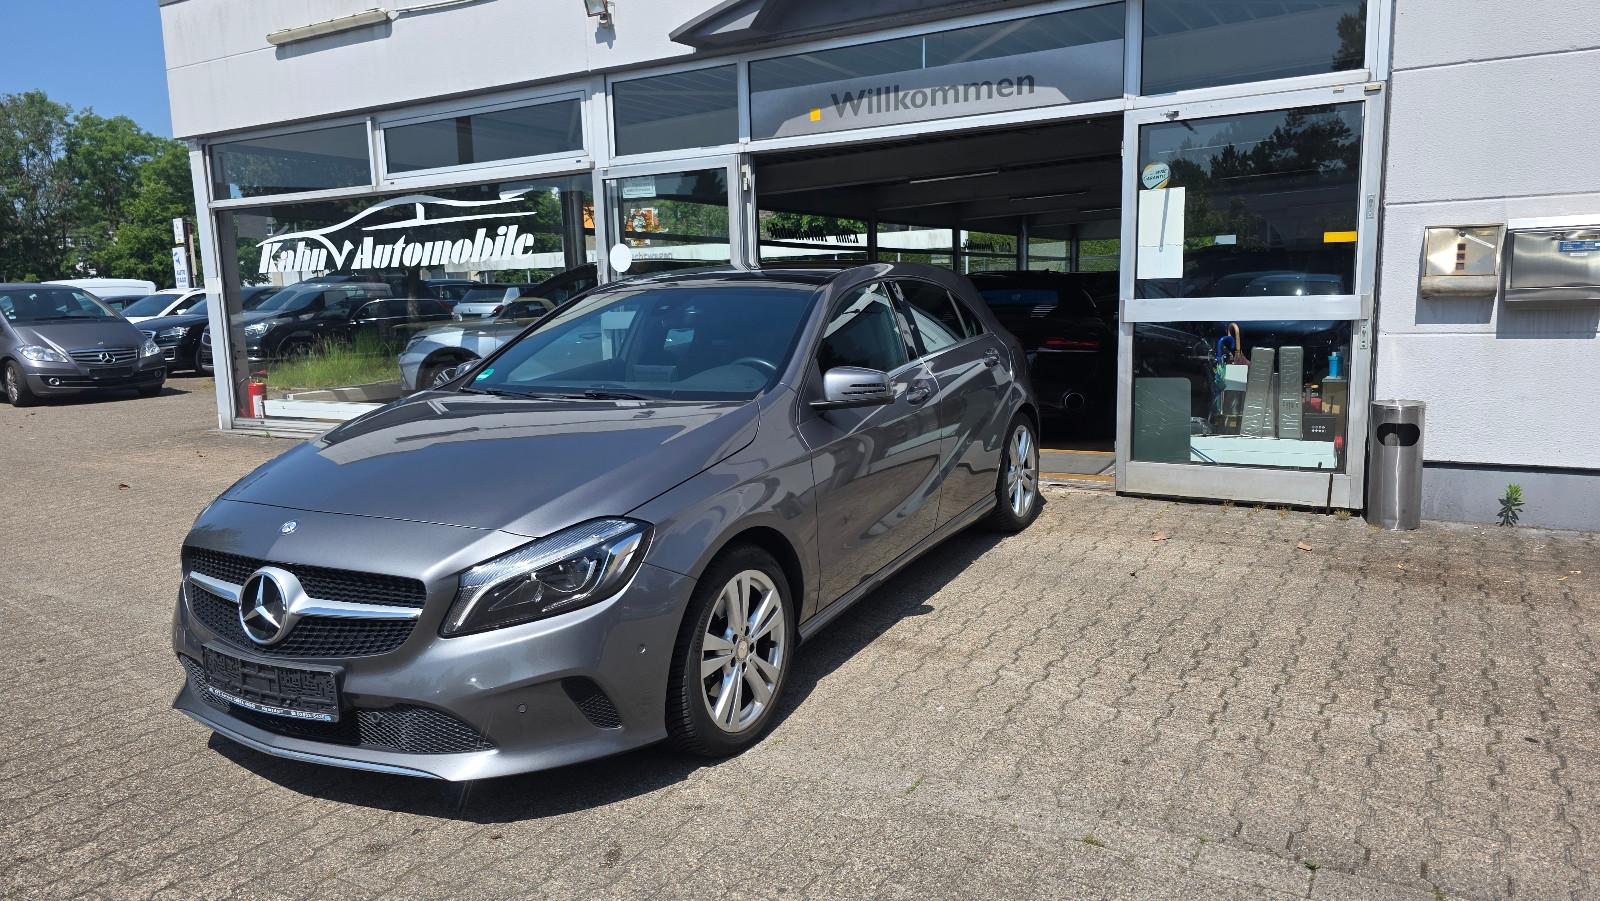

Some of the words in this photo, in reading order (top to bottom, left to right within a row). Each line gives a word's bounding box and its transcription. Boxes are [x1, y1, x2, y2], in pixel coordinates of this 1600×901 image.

[830, 73, 1035, 119] Willkommen
[259, 240, 328, 273] Kahn
[351, 225, 535, 270] Automobile
